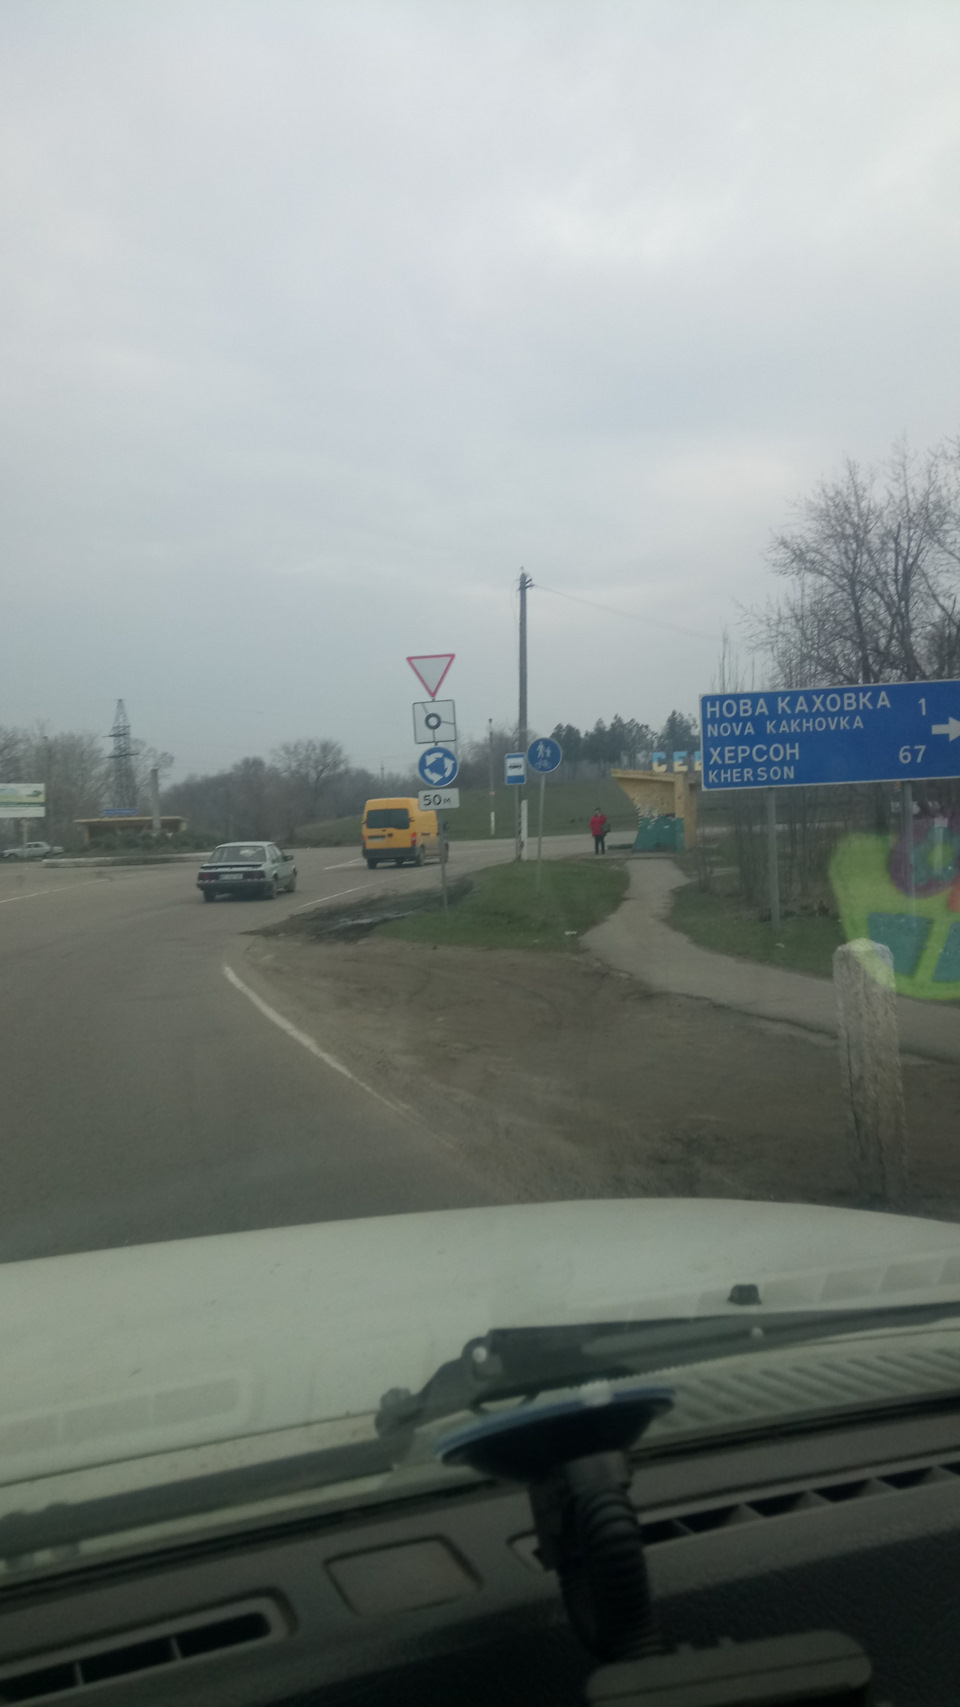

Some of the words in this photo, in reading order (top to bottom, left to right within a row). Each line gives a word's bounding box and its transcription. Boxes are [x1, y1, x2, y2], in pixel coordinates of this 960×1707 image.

[706, 698, 769, 719] НОВА
[777, 690, 891, 715] КАХОВКА
[918, 698, 926, 716] 1
[707, 721, 755, 738] NOVA
[766, 715, 864, 734] KAKHOVKA
[709, 742, 800, 765] ХЕРСОН
[899, 744, 926, 764] 67
[708, 766, 795, 784] KHERSON
